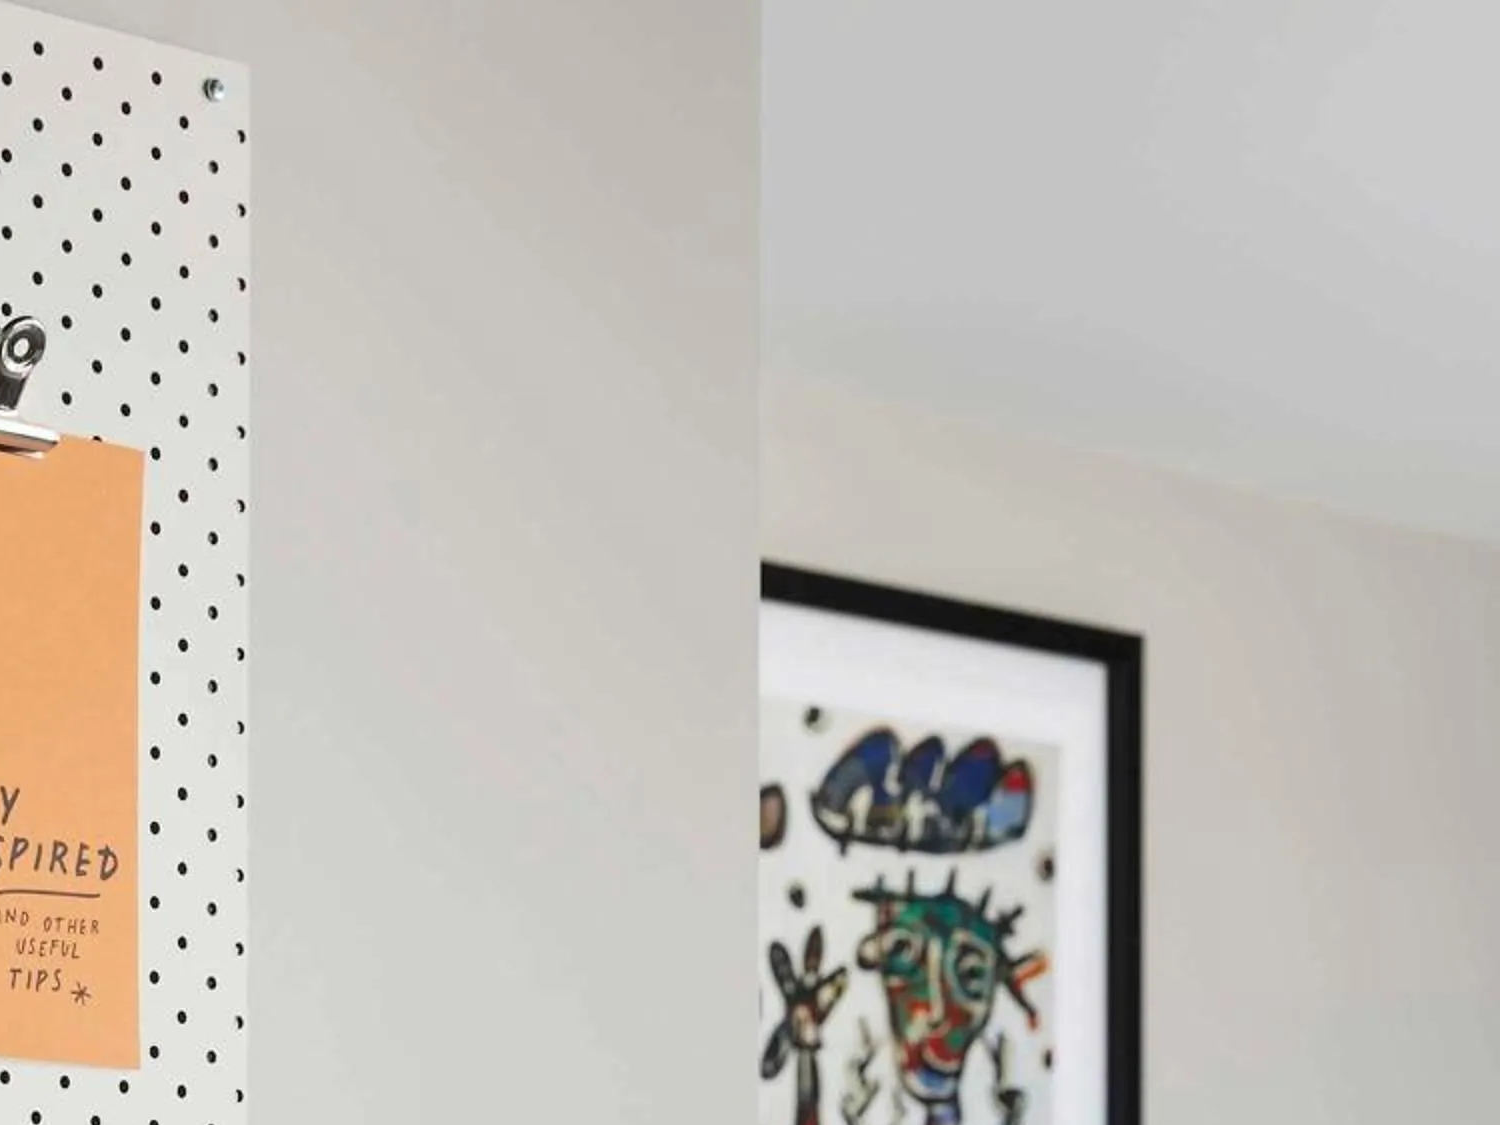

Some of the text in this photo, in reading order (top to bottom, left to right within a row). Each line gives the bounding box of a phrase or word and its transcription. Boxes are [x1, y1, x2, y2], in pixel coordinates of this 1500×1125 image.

[43, 916, 100, 935] OTHER
[16, 938, 81, 959] USEFUL
[8, 967, 62, 992] TIPS
